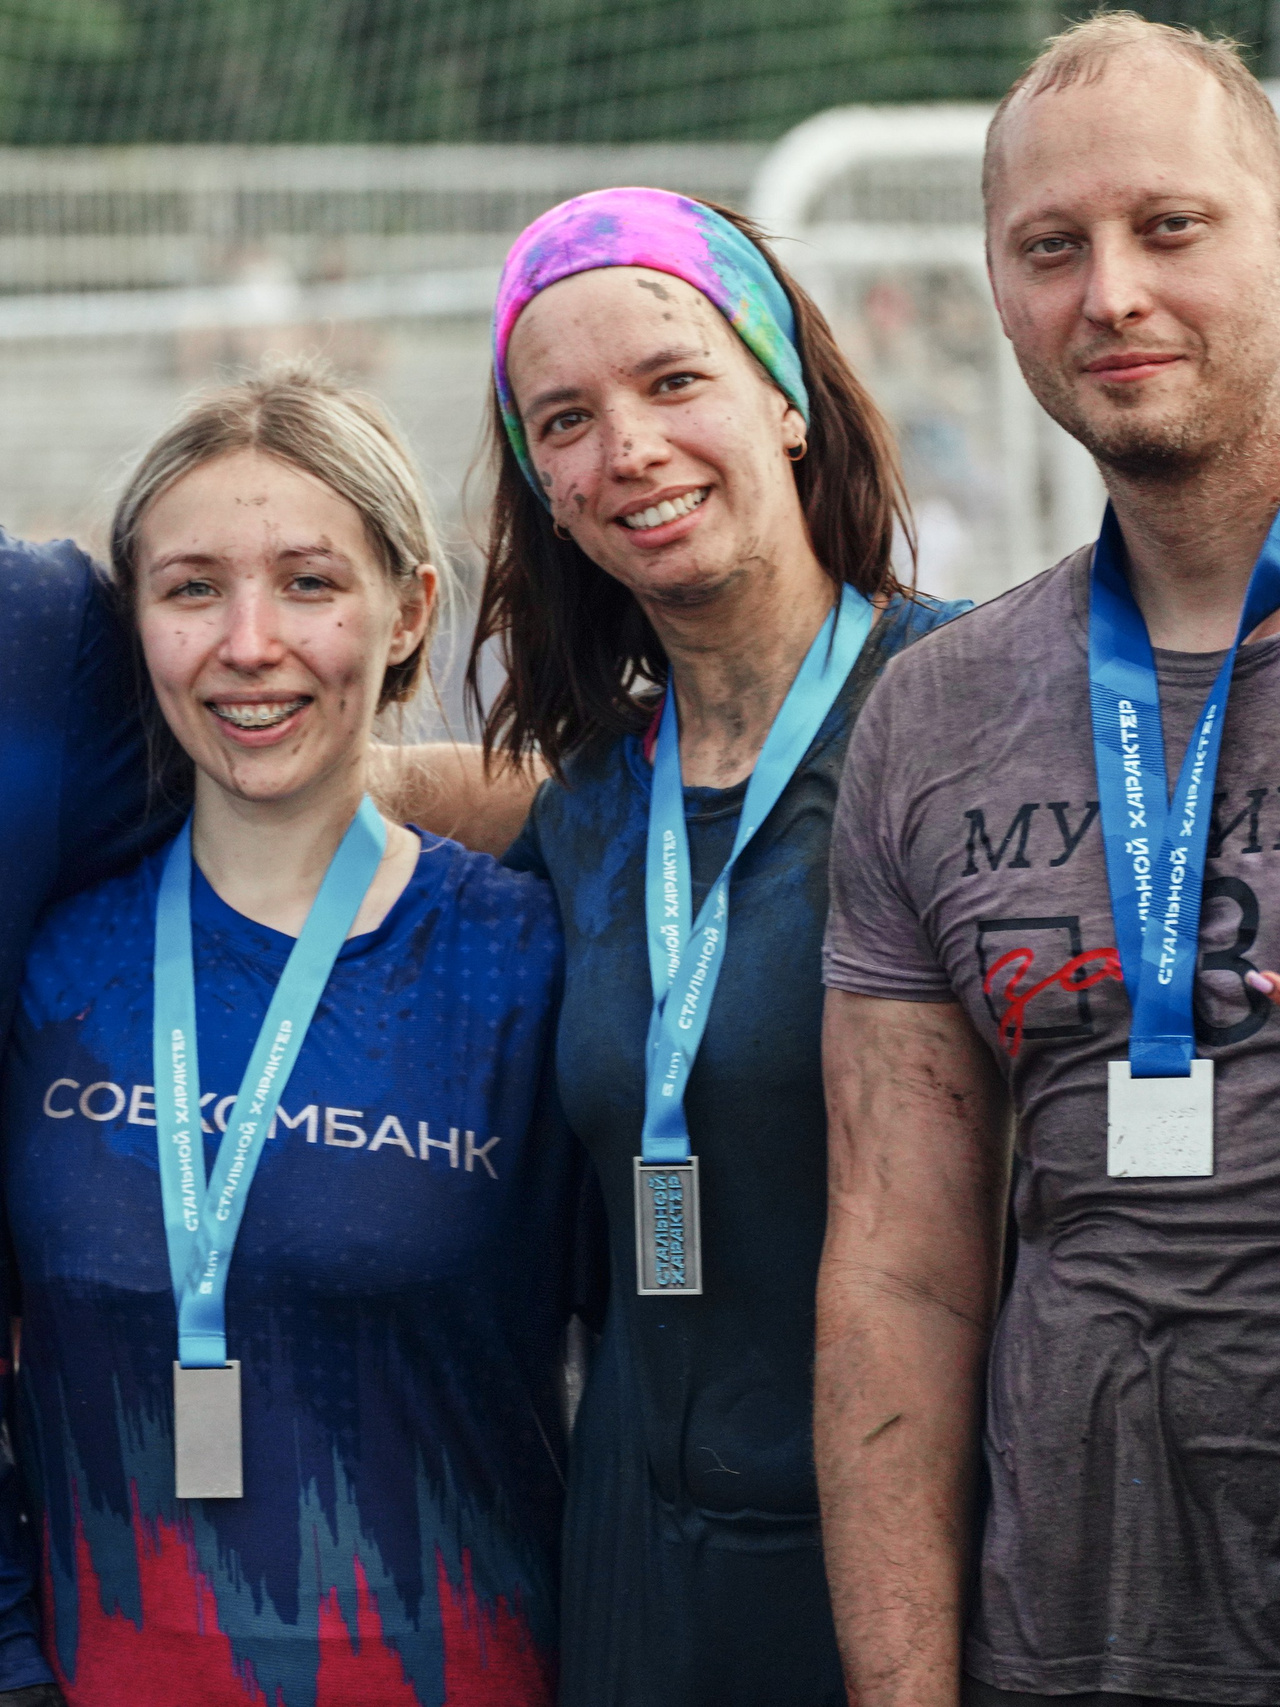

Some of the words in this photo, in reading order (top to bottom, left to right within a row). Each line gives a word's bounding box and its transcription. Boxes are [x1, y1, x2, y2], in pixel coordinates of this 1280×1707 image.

[1119, 700, 1148, 828] ХАРАКТЕР
[663, 829, 680, 918] ХАРАКТЕР
[1158, 847, 1188, 985] СТАЛЬНОЙ
[1179, 704, 1217, 836] ХАРАКТЕР
[678, 927, 720, 1030] СТАЛЬНОЙ
[172, 1029, 190, 1124] ХАРАКТЕР
[666, 1052, 681, 1079] km
[216, 1122, 258, 1221] СТАЛЬНОЙ
[249, 1020, 293, 1115] ХАРАКТЕР
[173, 1131, 199, 1231] СТАЛЬНОЙ
[648, 1175, 670, 1285] СТАЛЬНОЙ
[668, 1175, 685, 1285] ХАРАКТЕР
[206, 1250, 219, 1279] km
